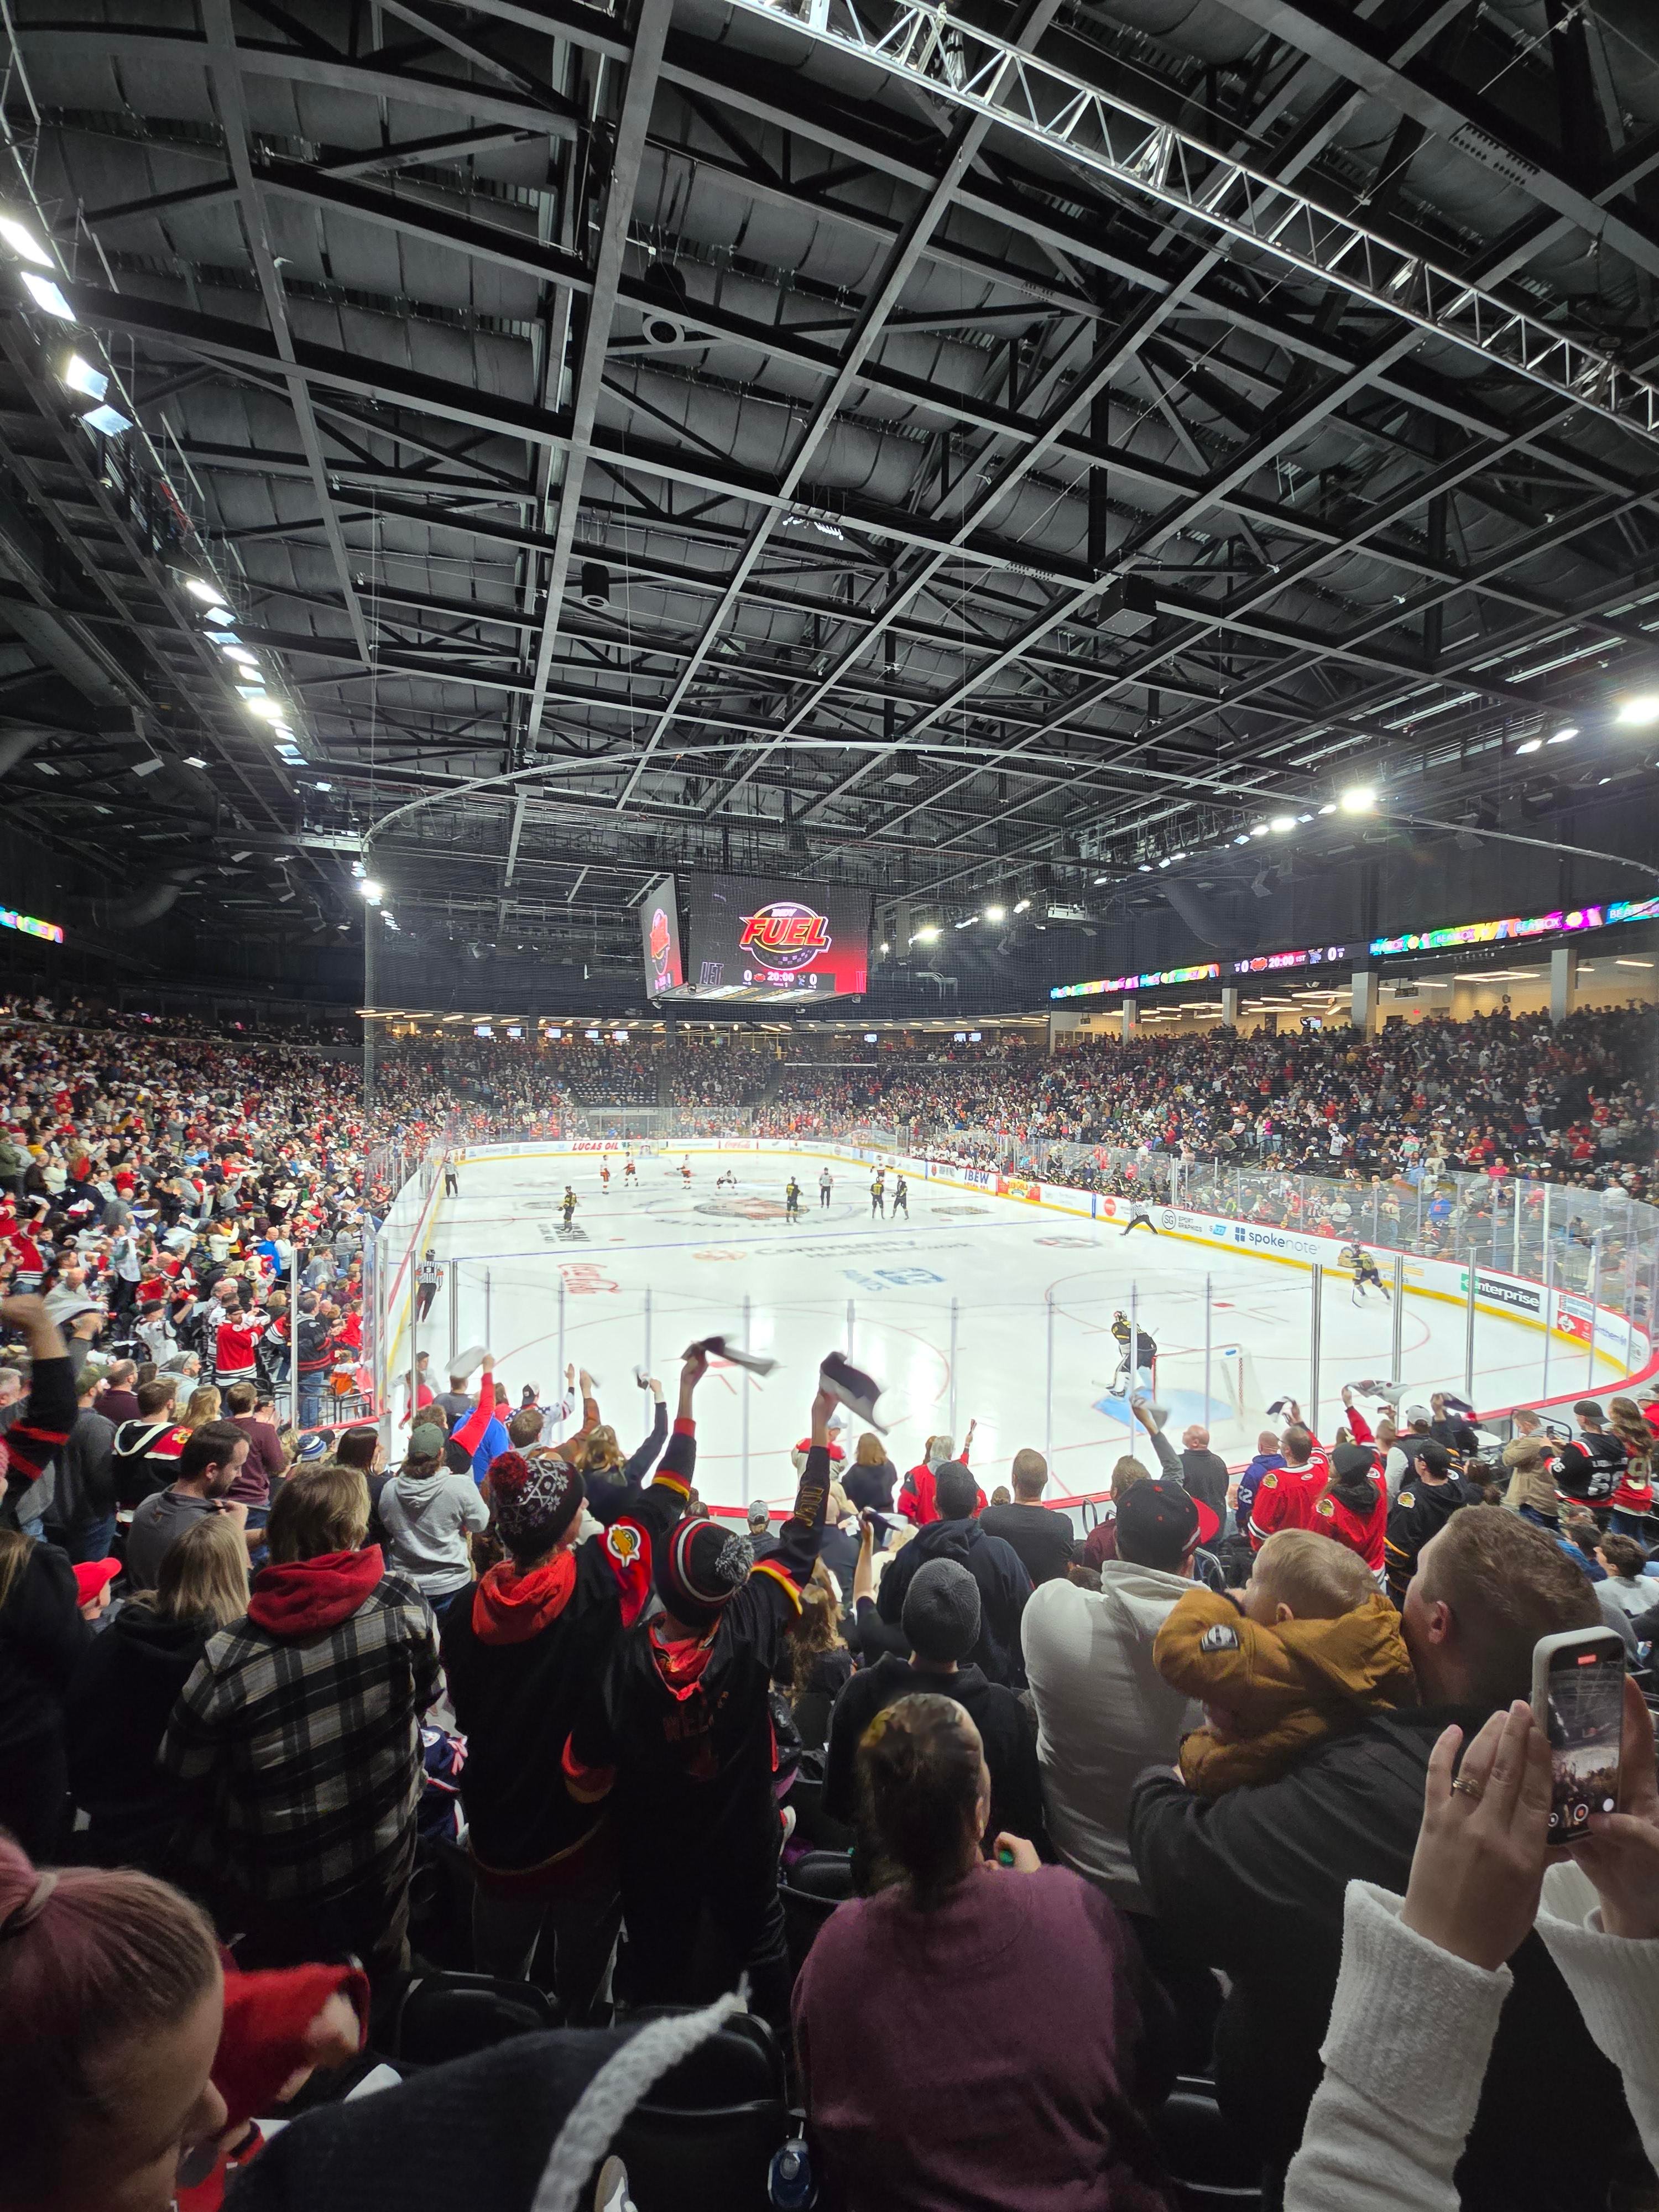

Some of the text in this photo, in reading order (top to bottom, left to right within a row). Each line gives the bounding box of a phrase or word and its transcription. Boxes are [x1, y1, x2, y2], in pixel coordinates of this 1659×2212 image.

[740, 917, 827, 946] FUEL
[1241, 961, 1249, 972] 0
[1268, 956, 1294, 968] 20:00
[1328, 947, 1337, 961] 0
[744, 970, 817, 985] 0 20:00 0
[964, 1169, 989, 1185] IBEW
[1164, 1215, 1173, 1225] SG
[1249, 1233, 1317, 1255] spokenote
[1462, 1278, 1540, 1307] enterprise
